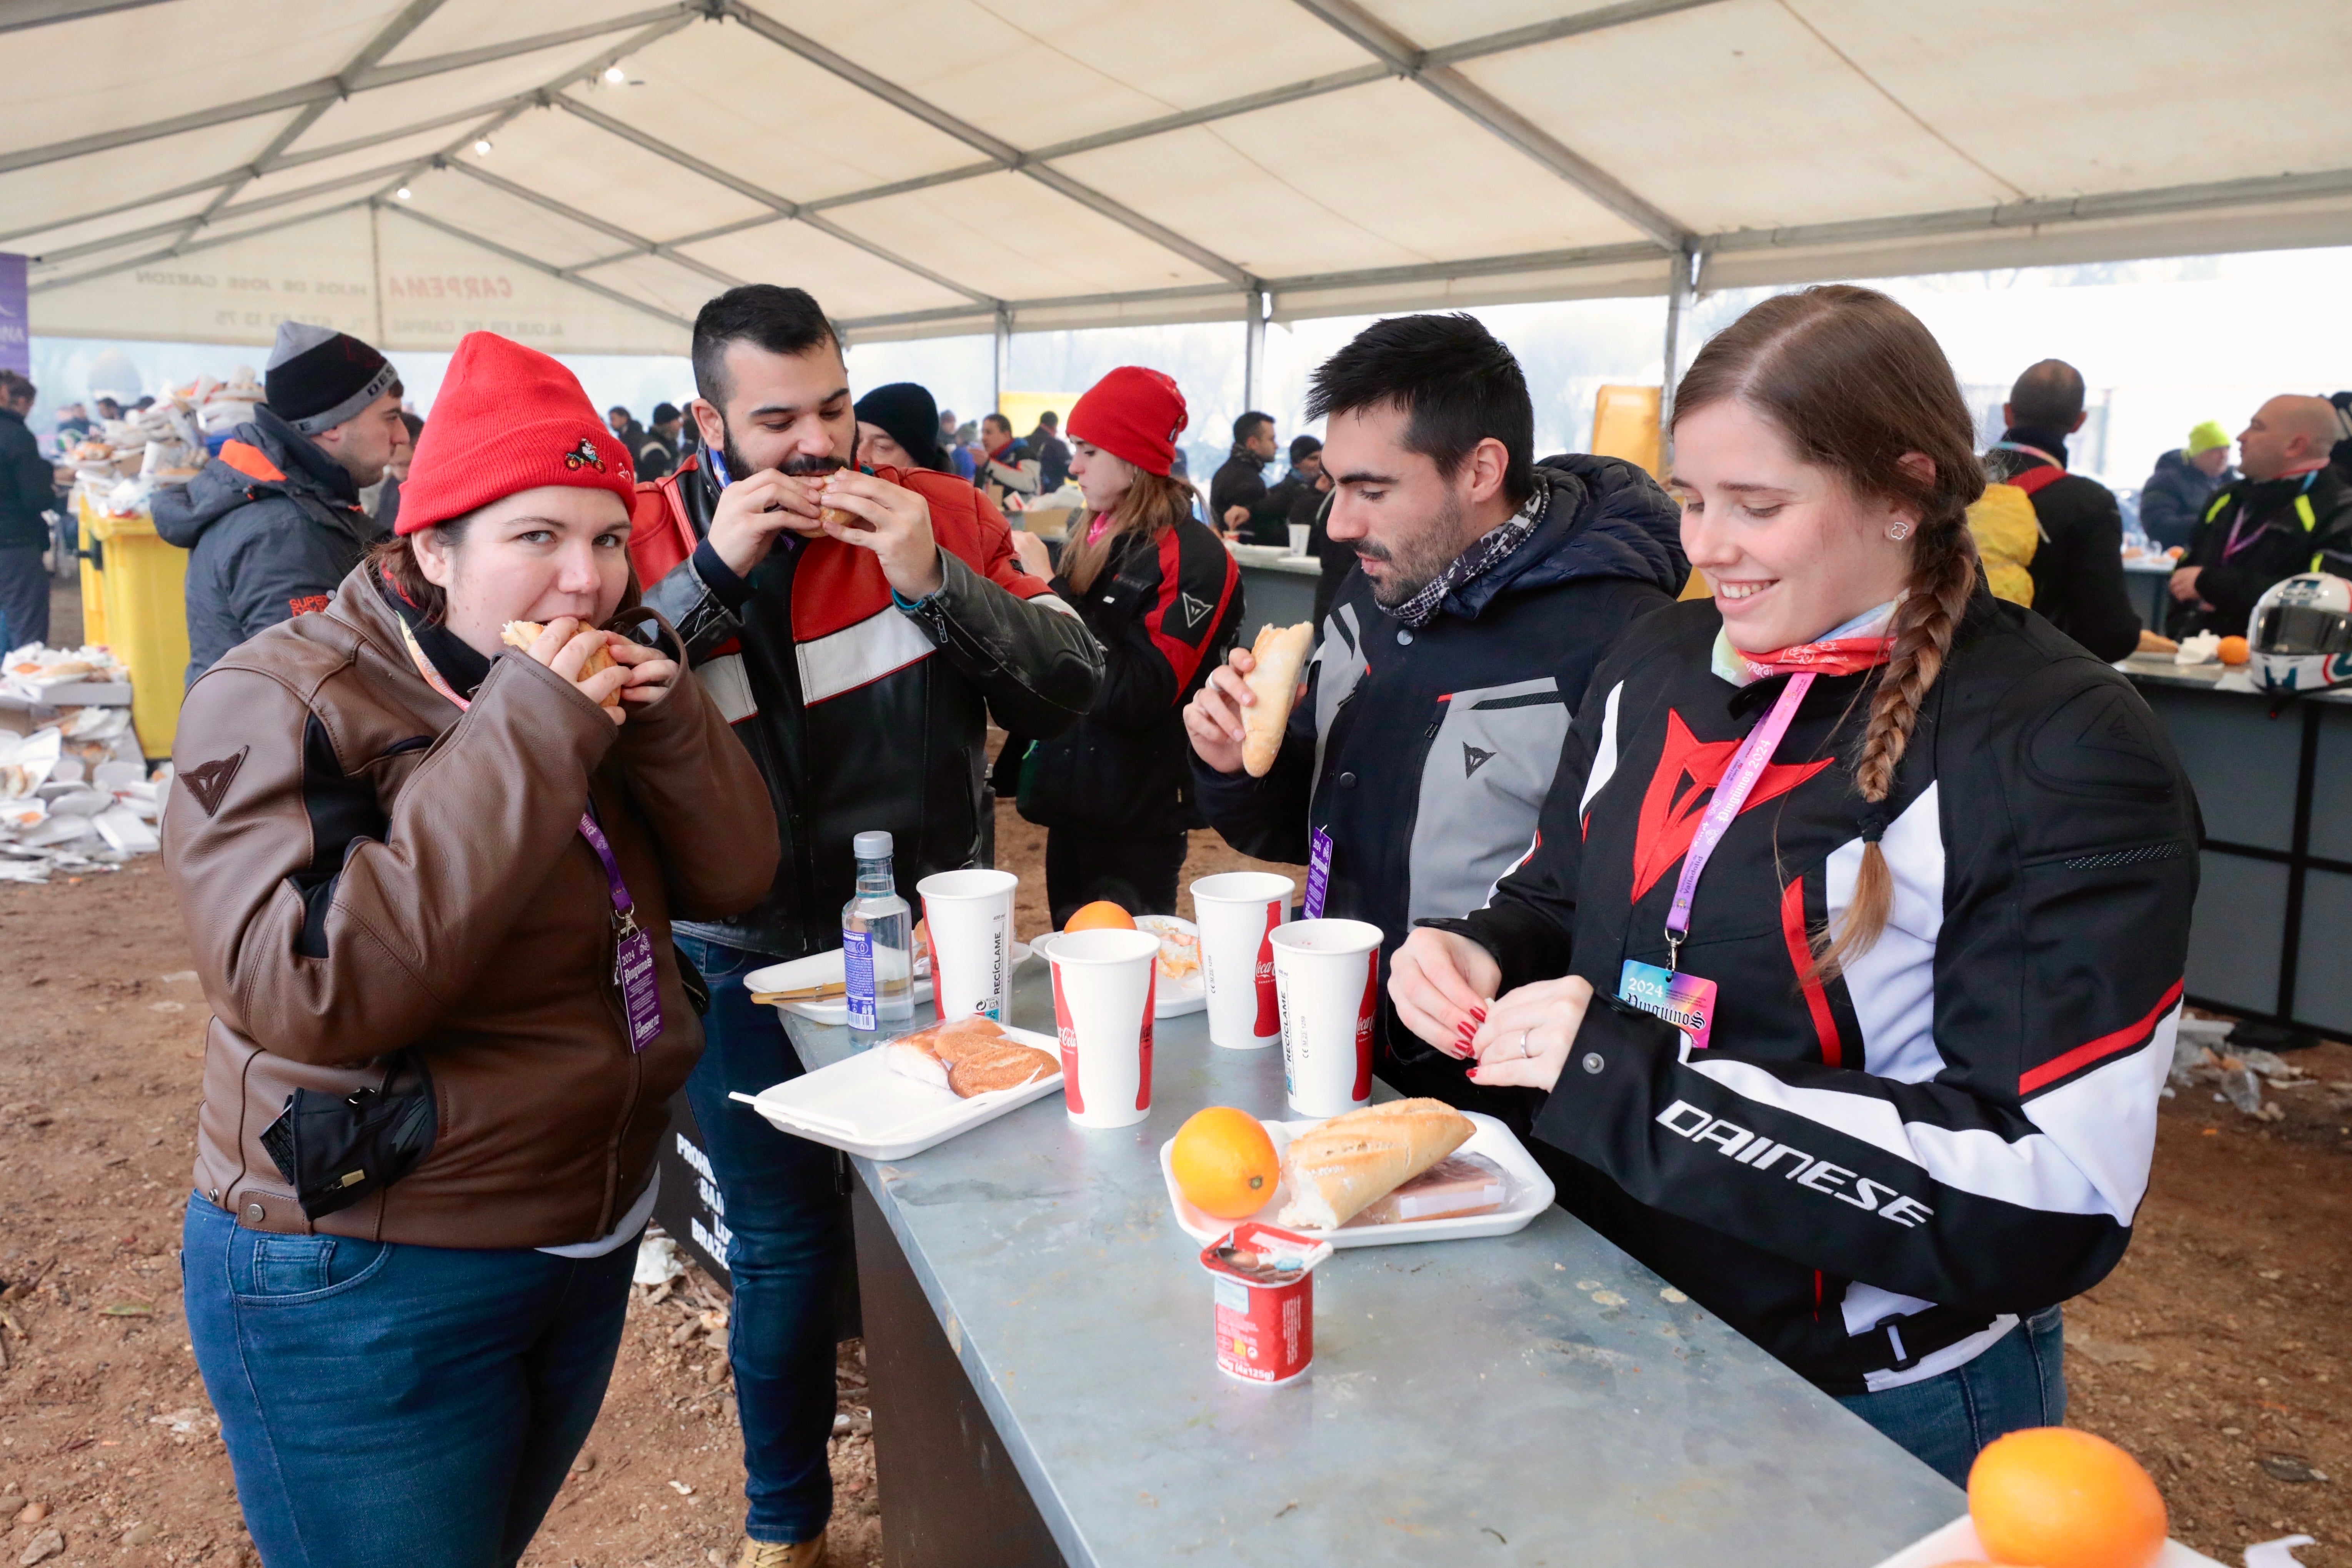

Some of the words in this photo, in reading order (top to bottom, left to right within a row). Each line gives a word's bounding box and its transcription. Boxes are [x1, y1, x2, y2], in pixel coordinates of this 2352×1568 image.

[1716, 770, 1754, 823] Pingüinos
[1748, 740, 1771, 770] 2024
[1683, 856, 1704, 894] Valladolid
[622, 949, 635, 966] 2024
[992, 931, 1001, 995] RECÍCLAME
[1627, 977, 1663, 997] 2024
[1281, 990, 1292, 1062] RECÍCLAME
[1654, 1099, 1934, 1228] DAINESE
